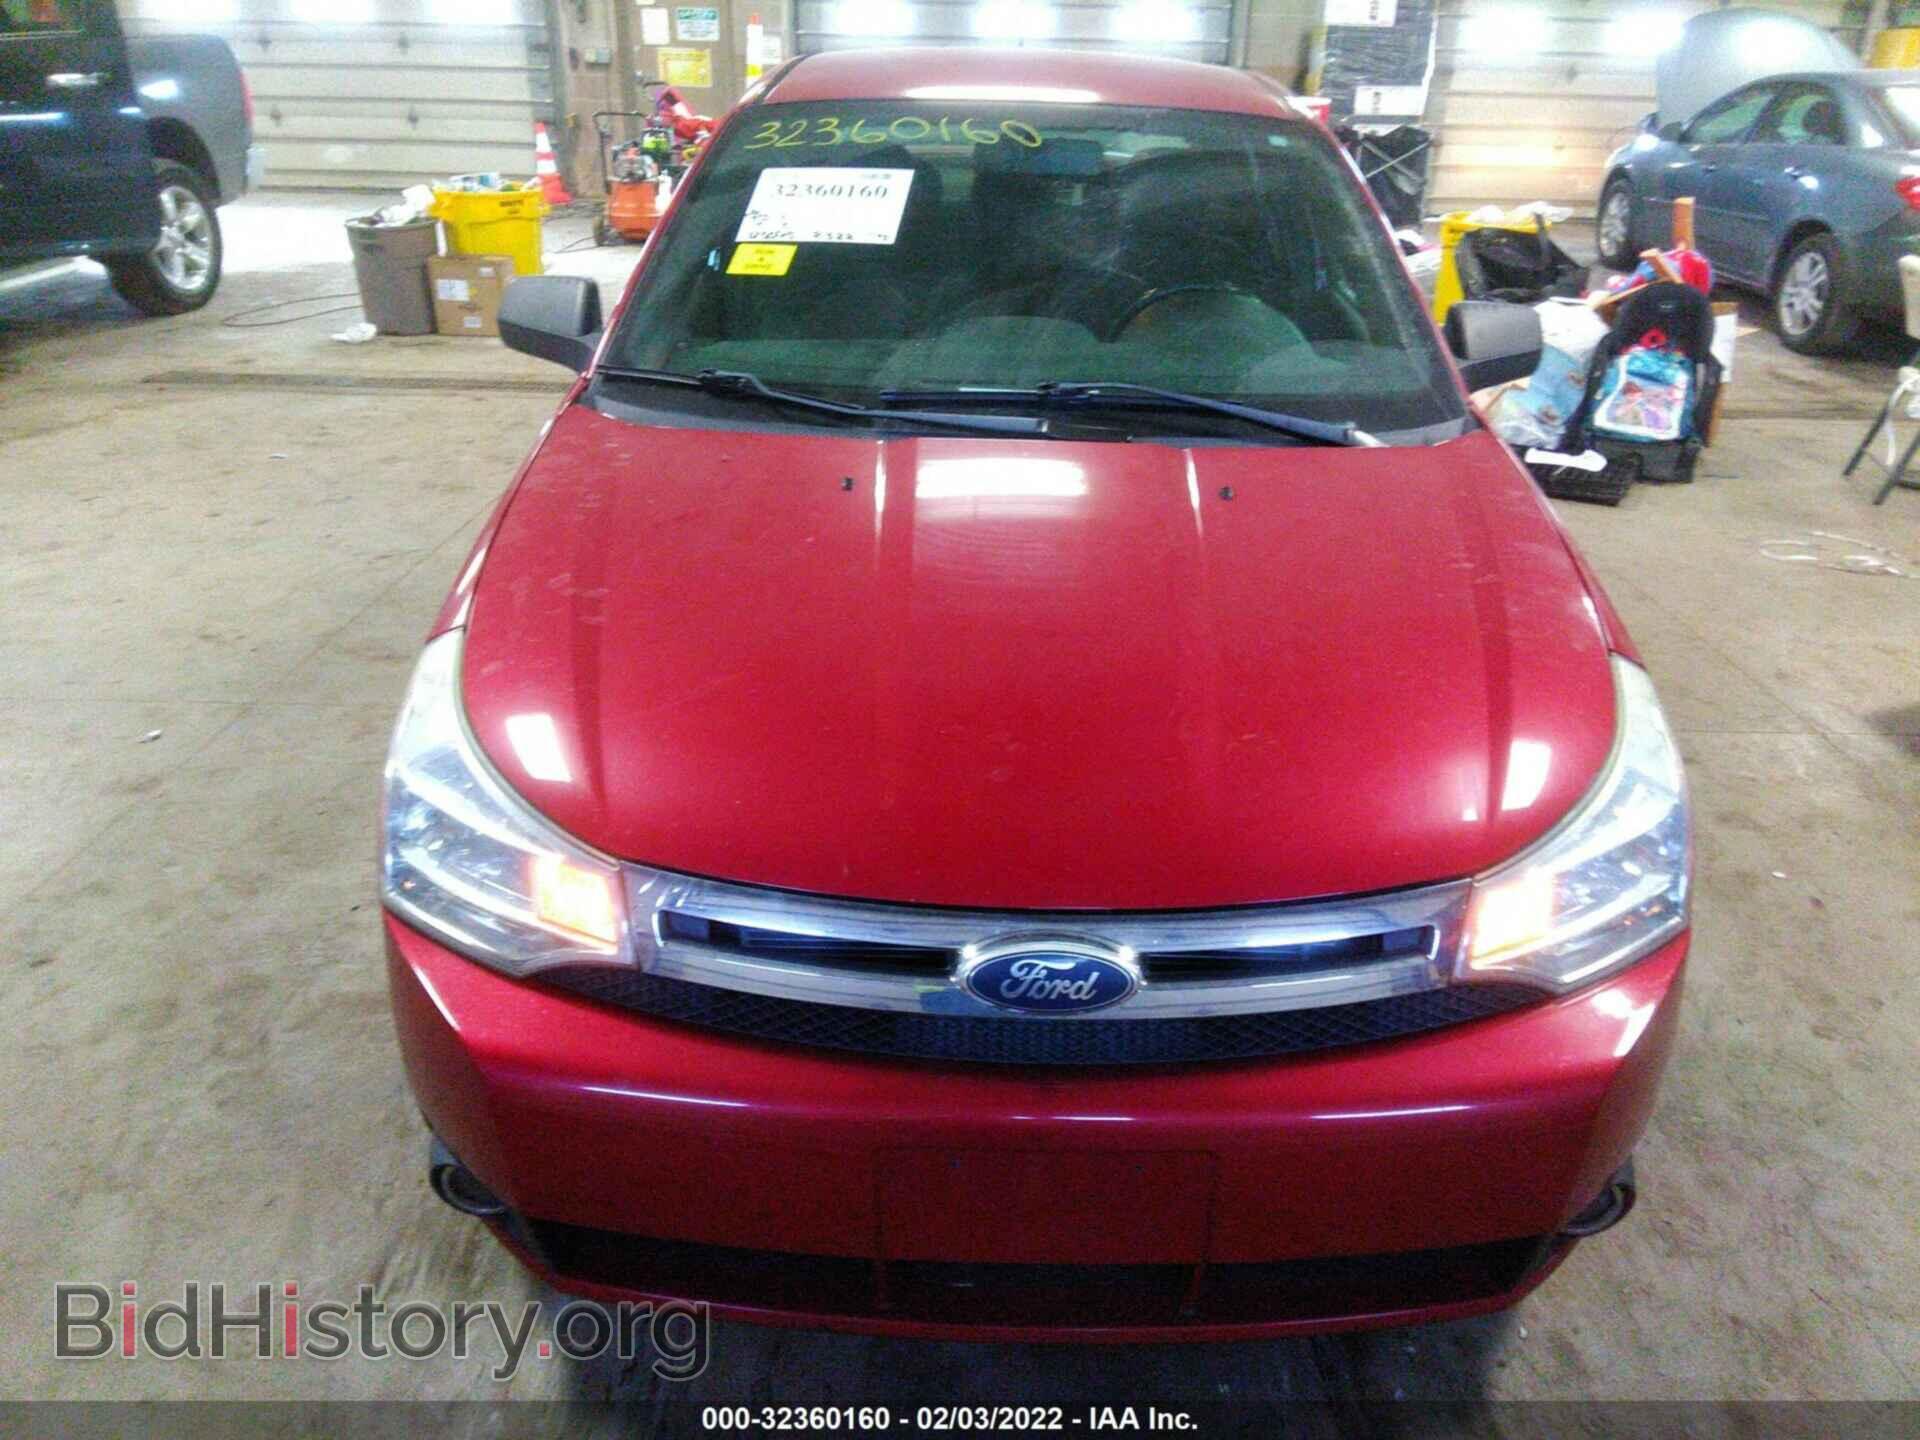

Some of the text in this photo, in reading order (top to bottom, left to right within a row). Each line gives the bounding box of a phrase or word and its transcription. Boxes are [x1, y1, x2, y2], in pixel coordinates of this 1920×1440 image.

[744, 116, 1042, 149] 32360160
[775, 183, 888, 199] 32360160
[999, 958, 1100, 1001] Ford
